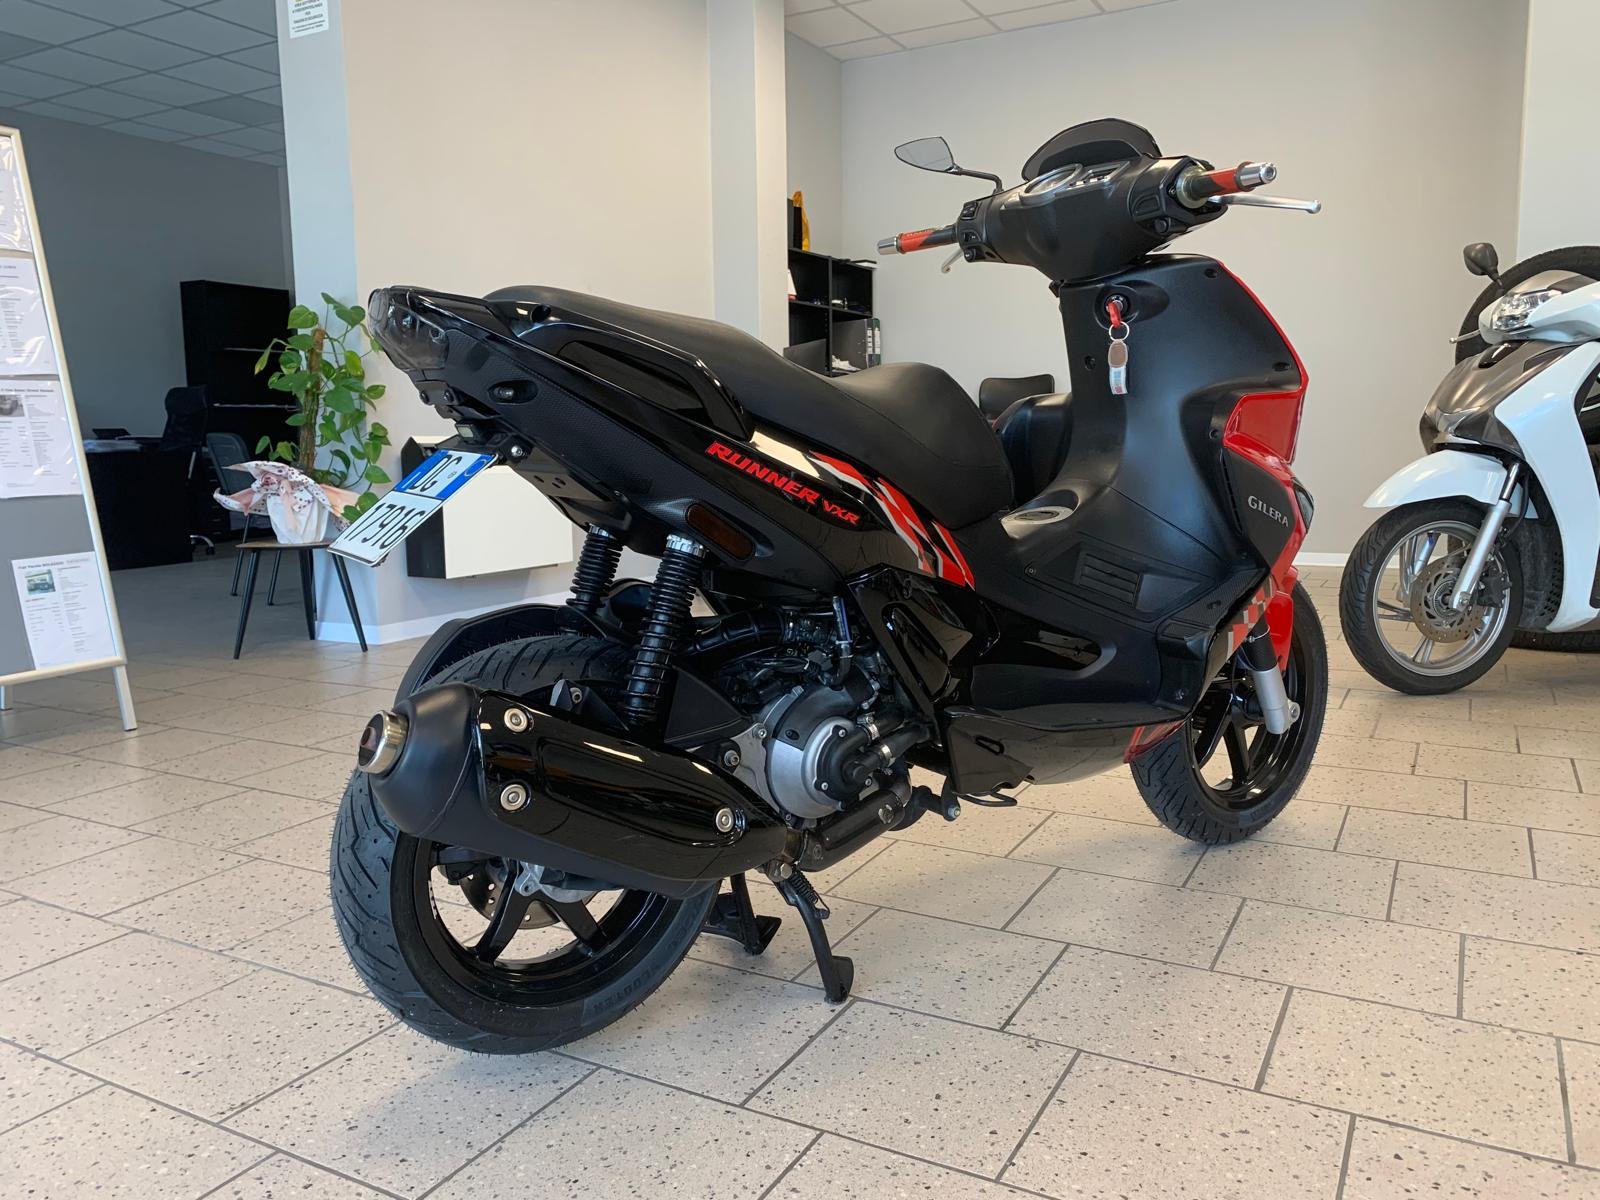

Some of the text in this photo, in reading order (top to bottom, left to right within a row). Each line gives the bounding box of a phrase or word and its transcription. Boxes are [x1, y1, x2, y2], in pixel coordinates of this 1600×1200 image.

[408, 453, 463, 493] DG
[705, 440, 861, 525] RUNNER VXR
[343, 502, 426, 550] 17916
[1247, 495, 1289, 528] GILERA
